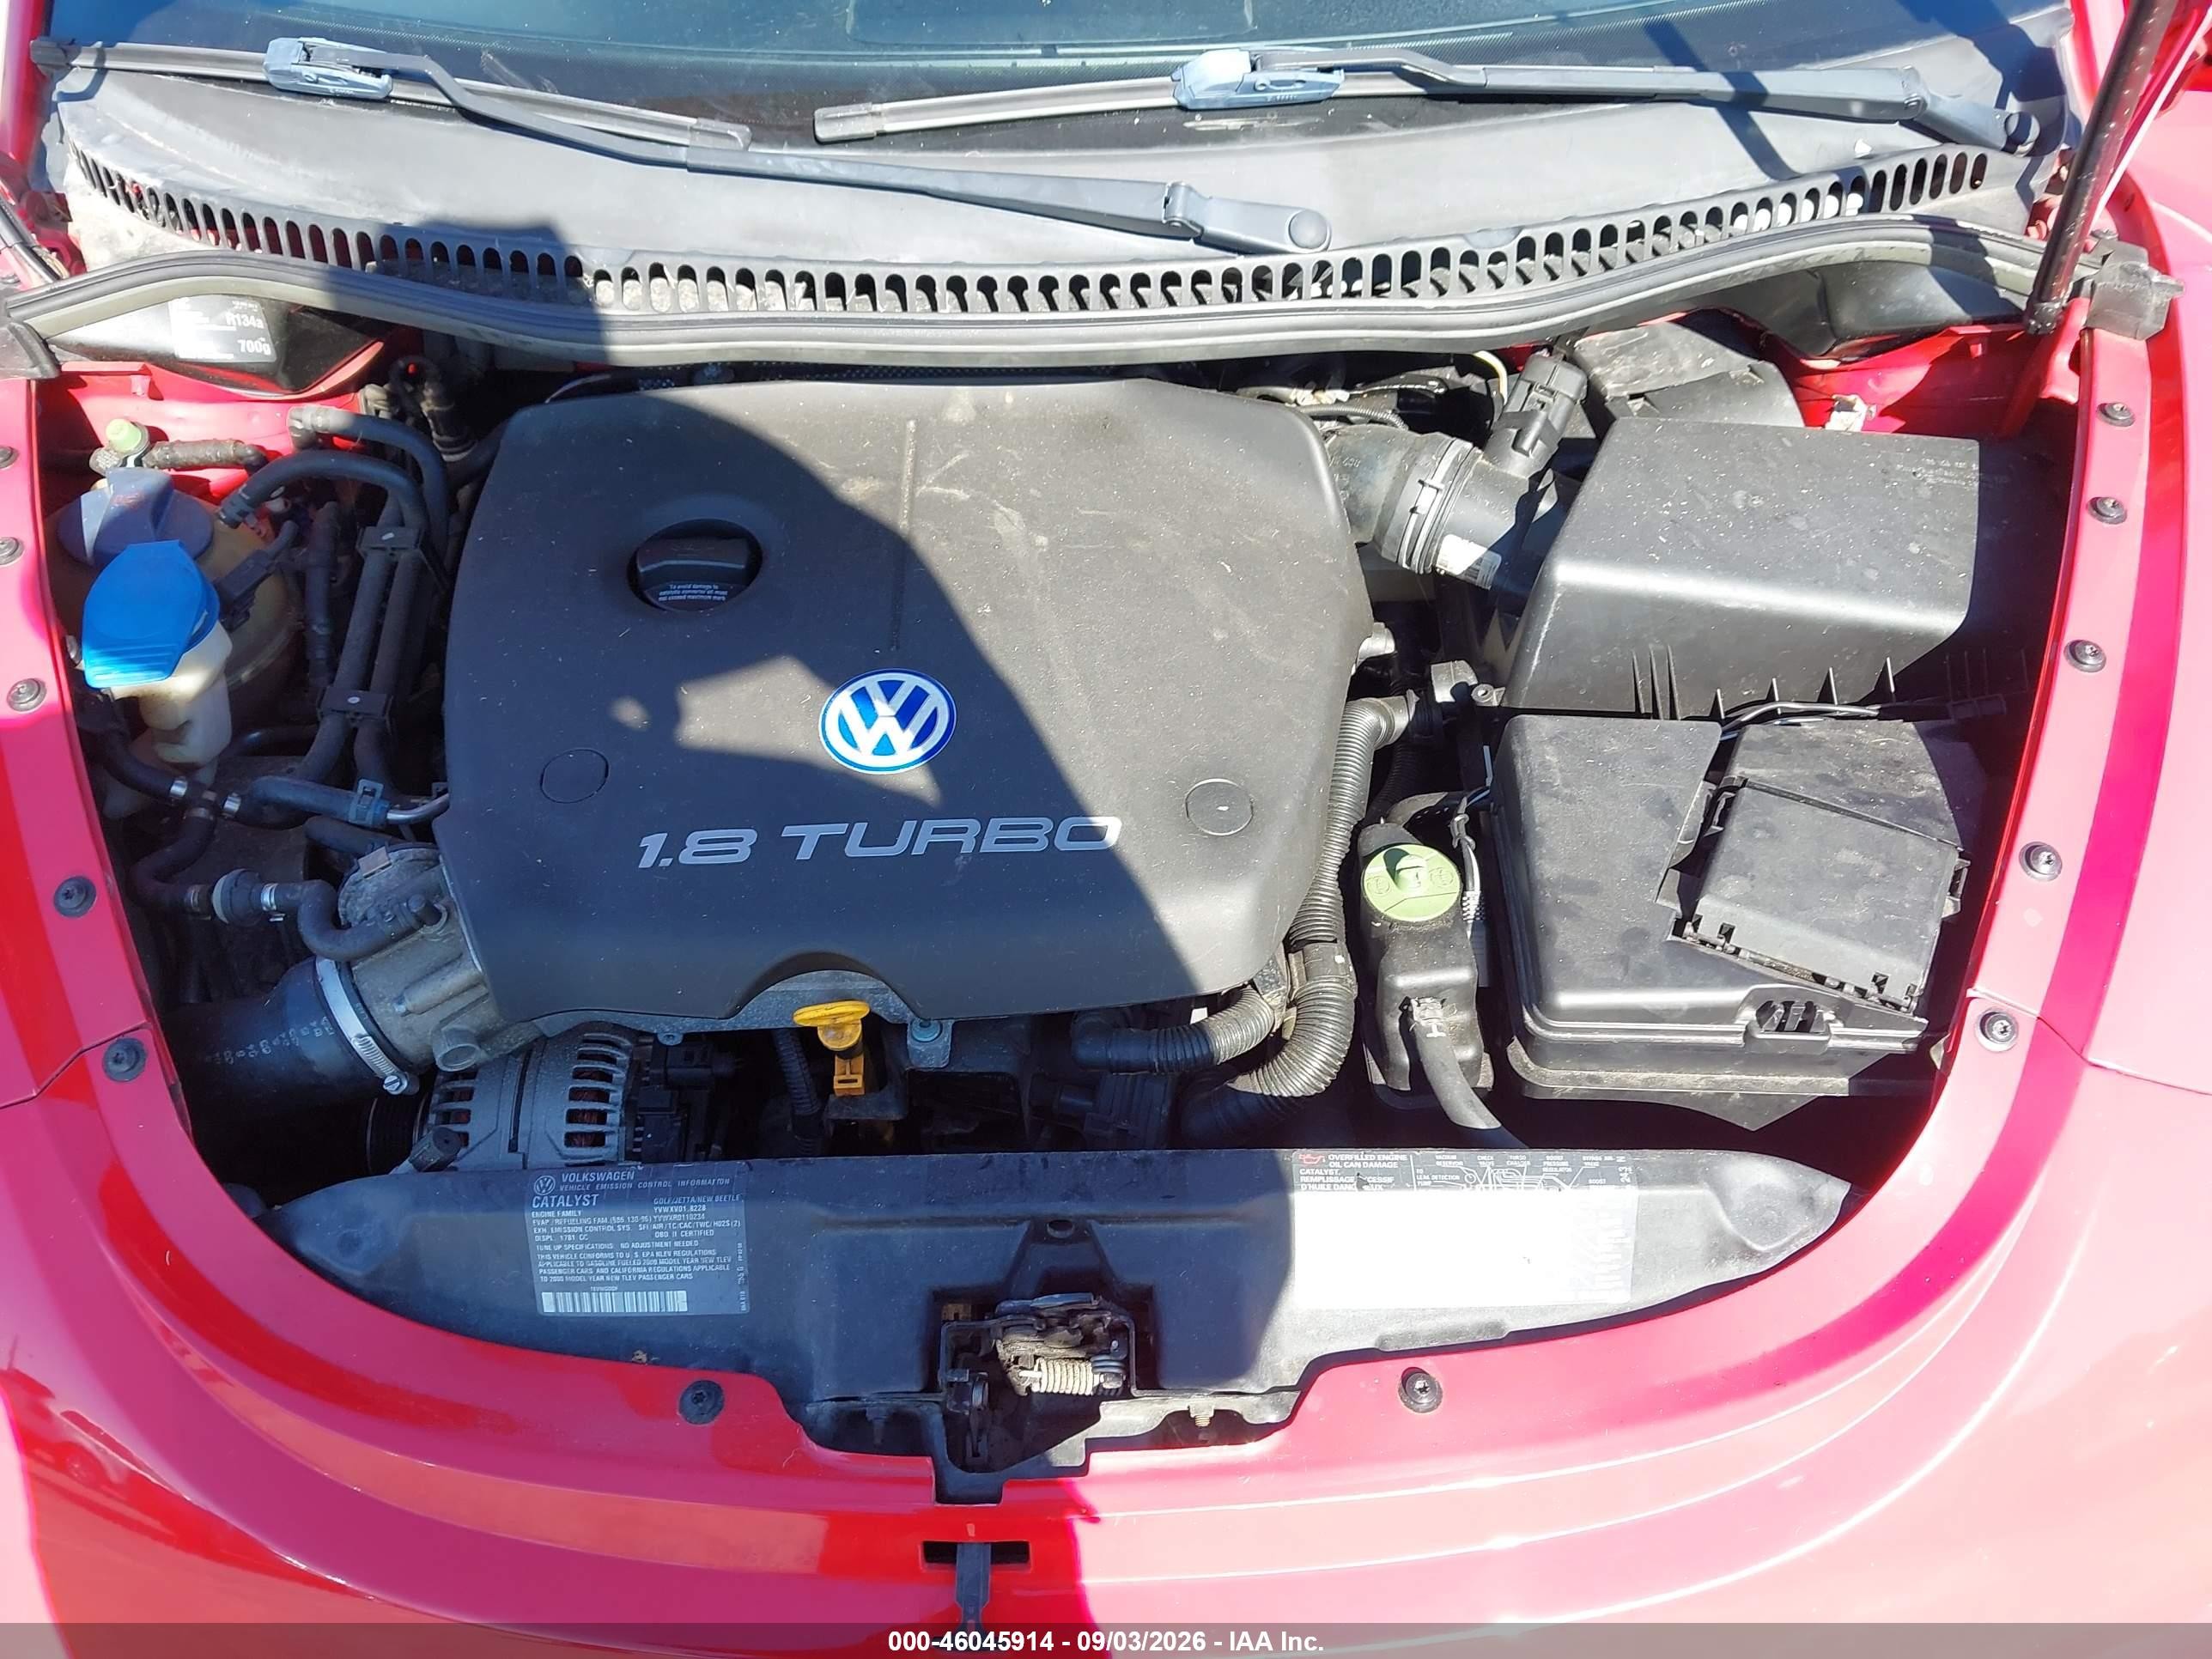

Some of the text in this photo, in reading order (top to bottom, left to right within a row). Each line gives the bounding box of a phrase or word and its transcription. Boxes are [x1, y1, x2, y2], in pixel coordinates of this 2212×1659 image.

[237, 338, 271, 356] 700g
[638, 816, 1122, 869] 1.8 TURBO
[562, 1170, 635, 1182] VOLKSWAGEN
[678, 1178, 730, 1187] INFORMATION
[532, 1194, 599, 1208] CATALYST
[680, 1229, 714, 1237] CERTIFIED
